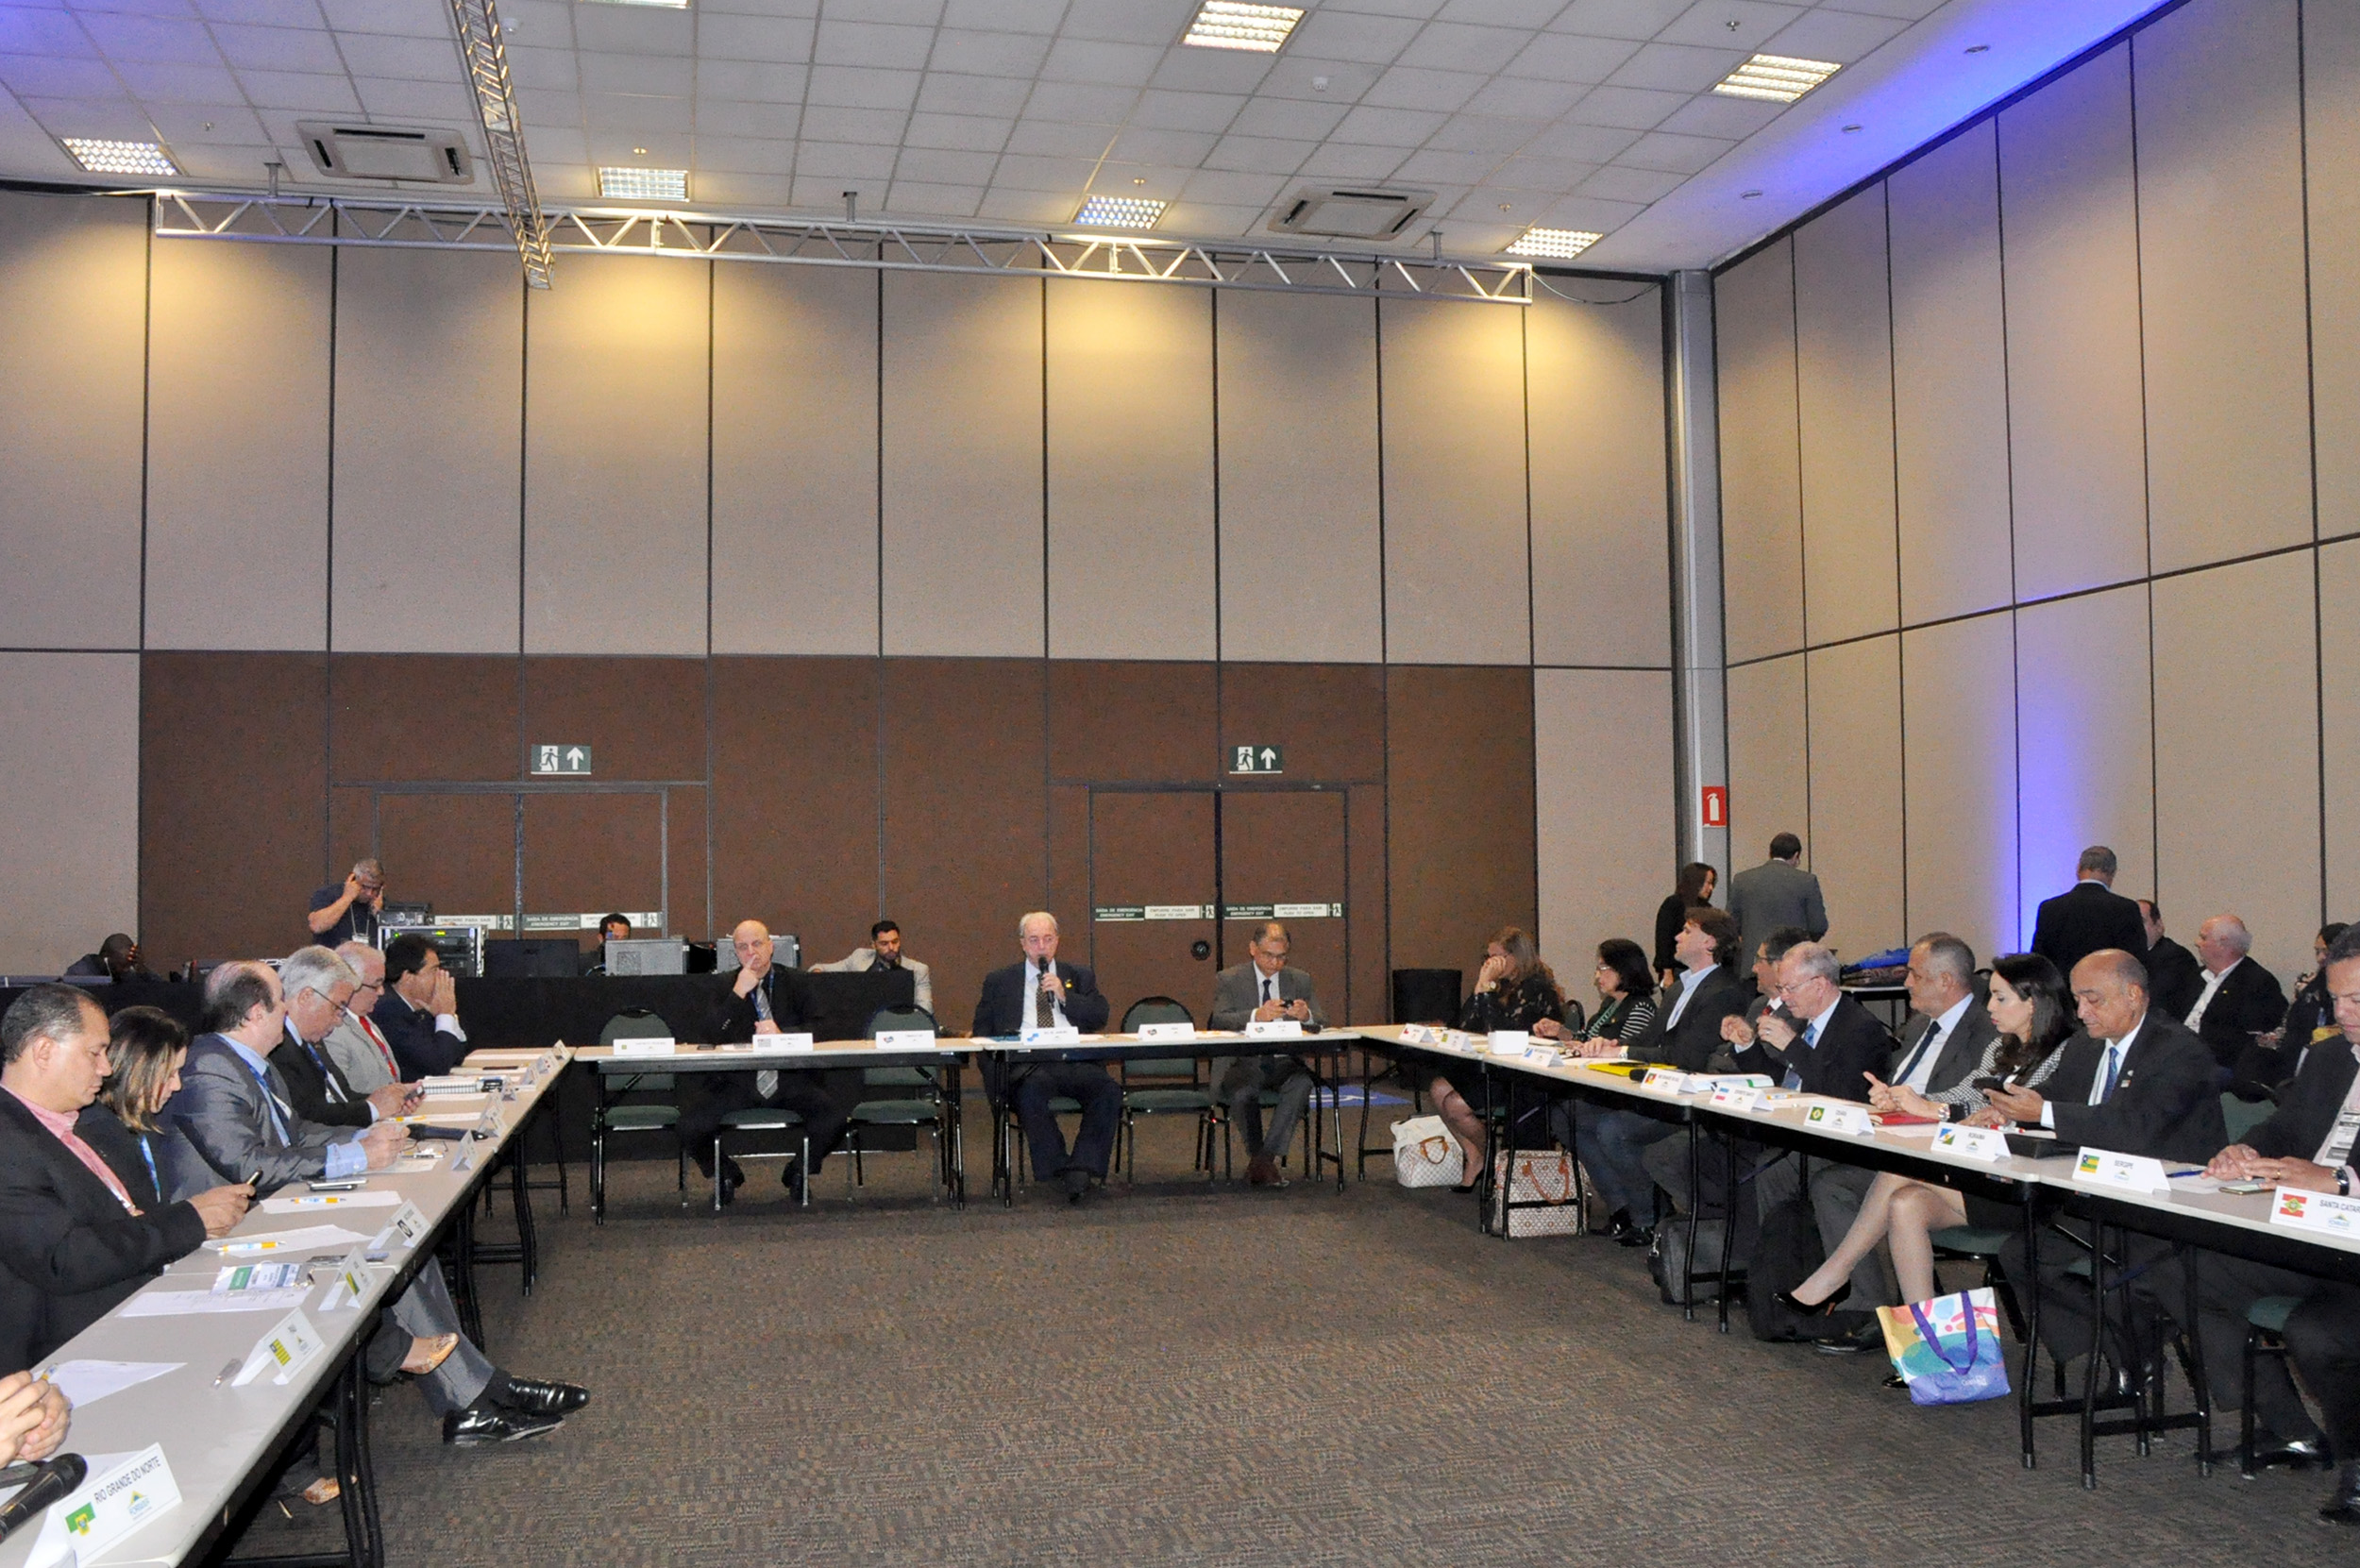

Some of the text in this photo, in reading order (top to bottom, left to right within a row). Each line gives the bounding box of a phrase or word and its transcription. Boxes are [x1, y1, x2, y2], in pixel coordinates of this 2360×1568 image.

[2319, 1199, 2339, 1209] SANTA
[93, 1456, 161, 1505] RIO GRANDE DO NORTE
